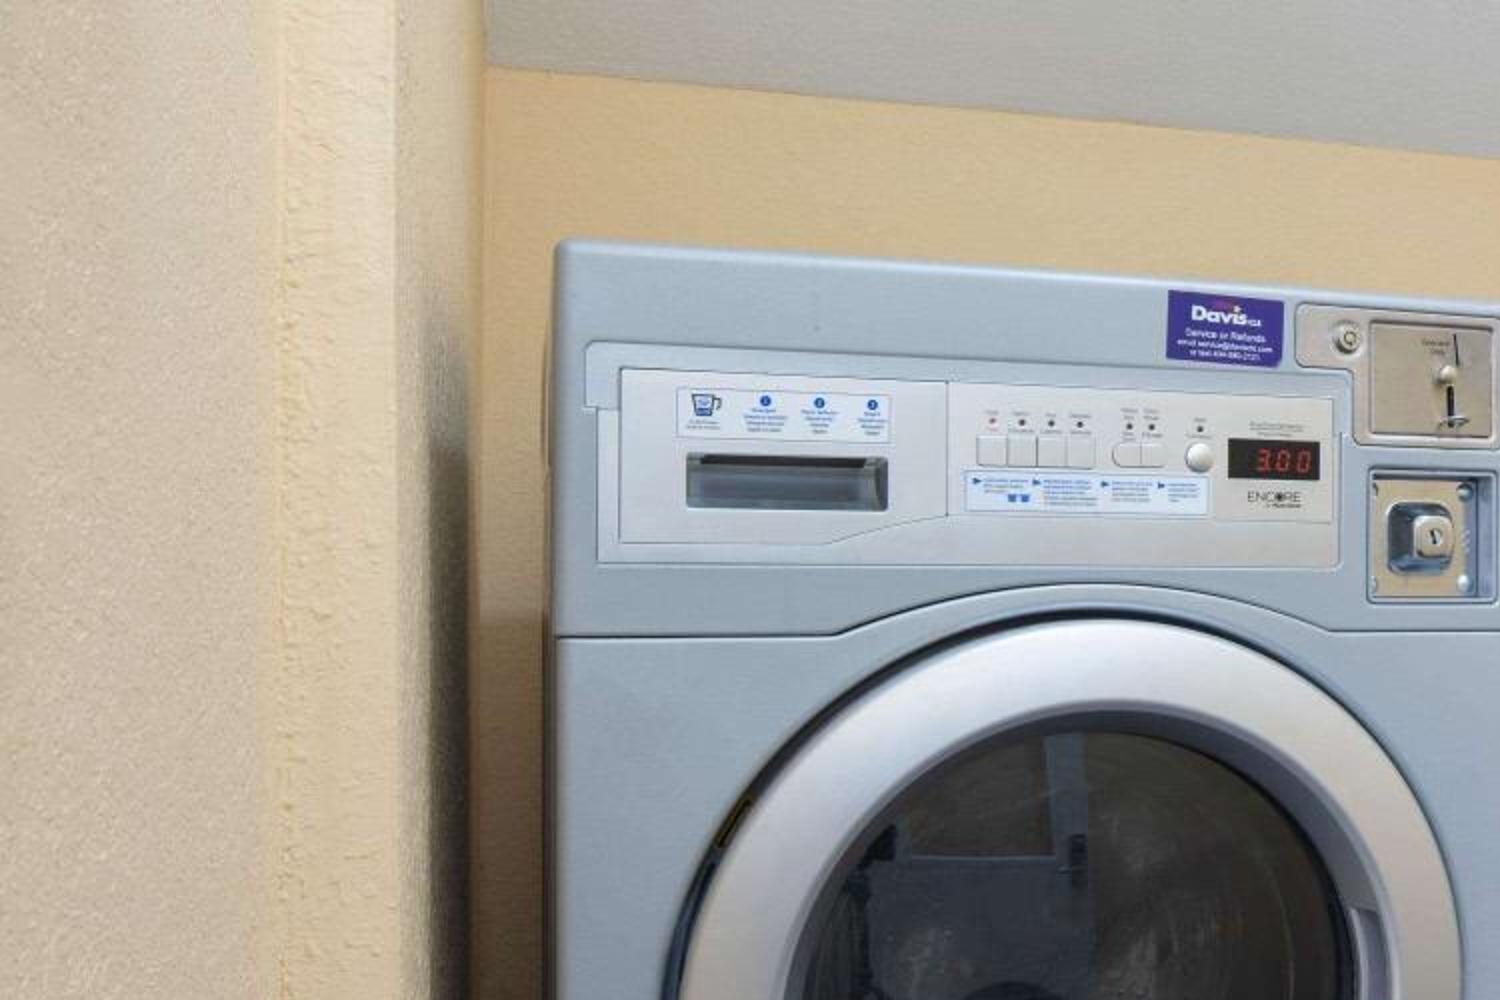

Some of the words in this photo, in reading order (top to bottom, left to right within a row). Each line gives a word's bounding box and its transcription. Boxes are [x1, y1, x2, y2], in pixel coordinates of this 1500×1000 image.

[1191, 304, 1248, 326] Davis
[1185, 327, 1218, 339] Service
[1220, 332, 1229, 340] or
[1247, 490, 1303, 503] ENCORE
